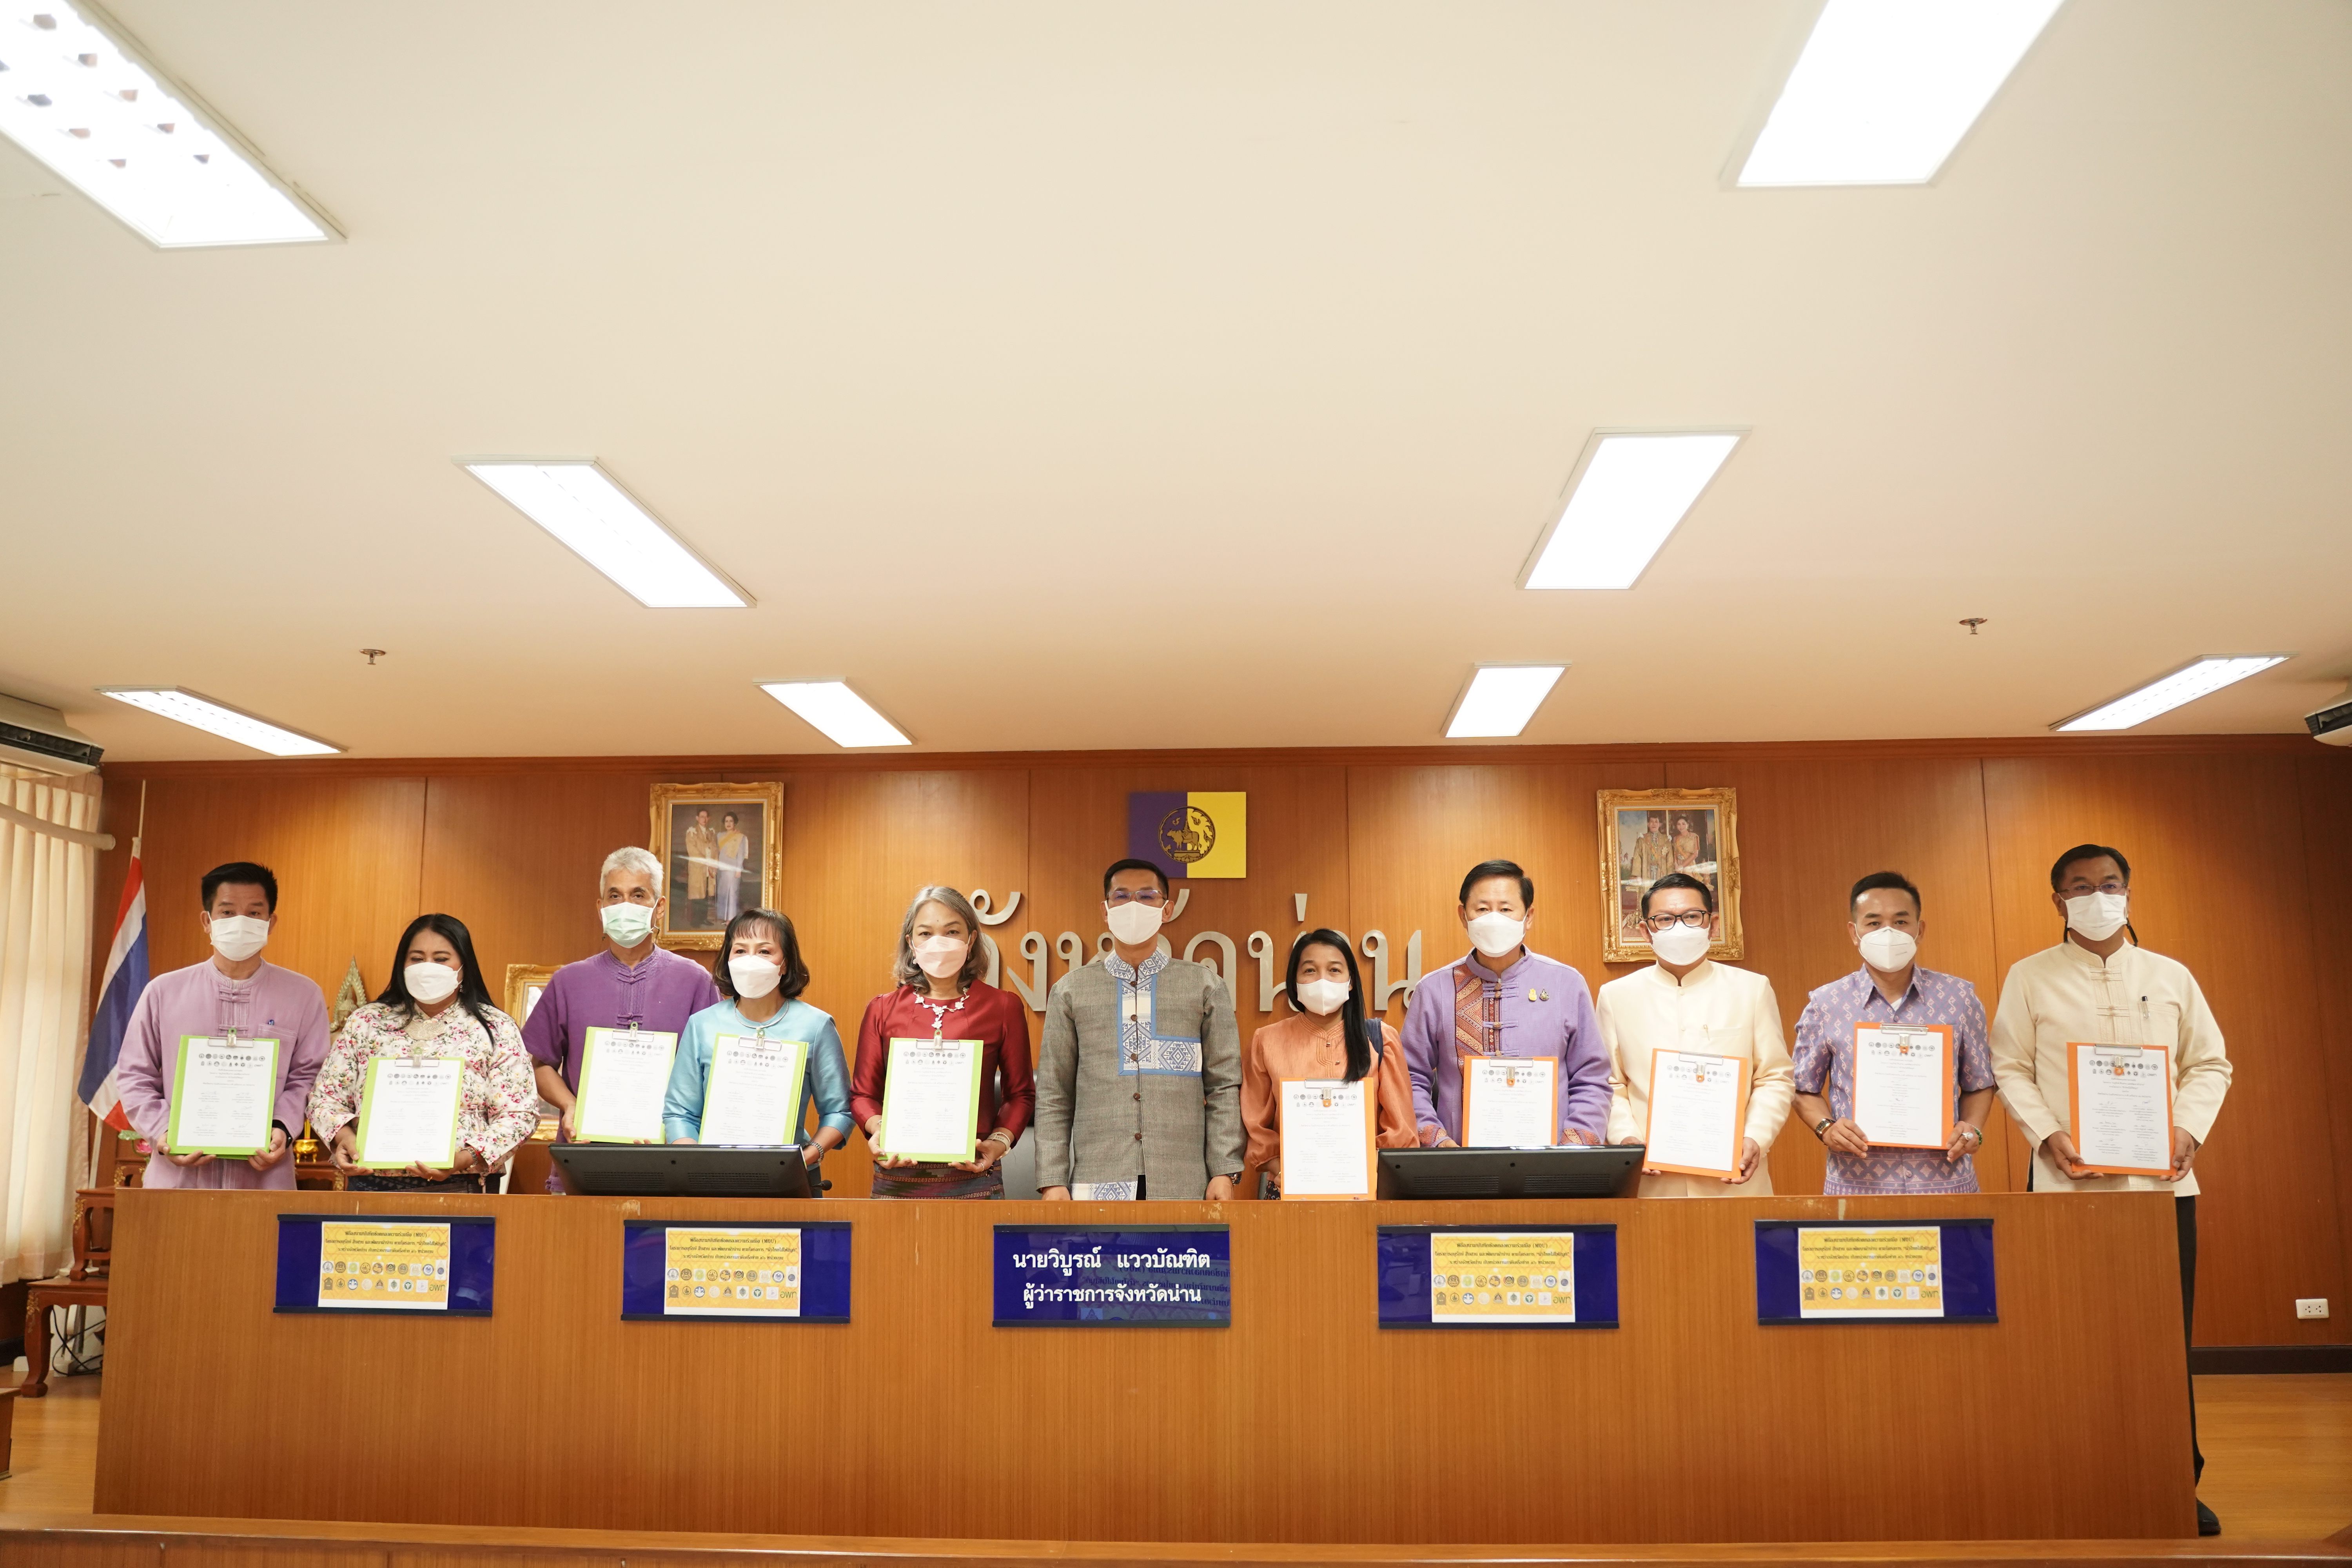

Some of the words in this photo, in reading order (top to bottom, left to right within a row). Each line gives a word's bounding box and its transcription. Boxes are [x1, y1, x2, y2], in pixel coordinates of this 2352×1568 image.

[1013, 1246, 1102, 1276] นายวิบูรณ์
[1118, 1247, 1210, 1269] แววบัณฑิต
[1023, 1282, 1201, 1309] ผู้ว่าราชการจังหวัดน่าน
